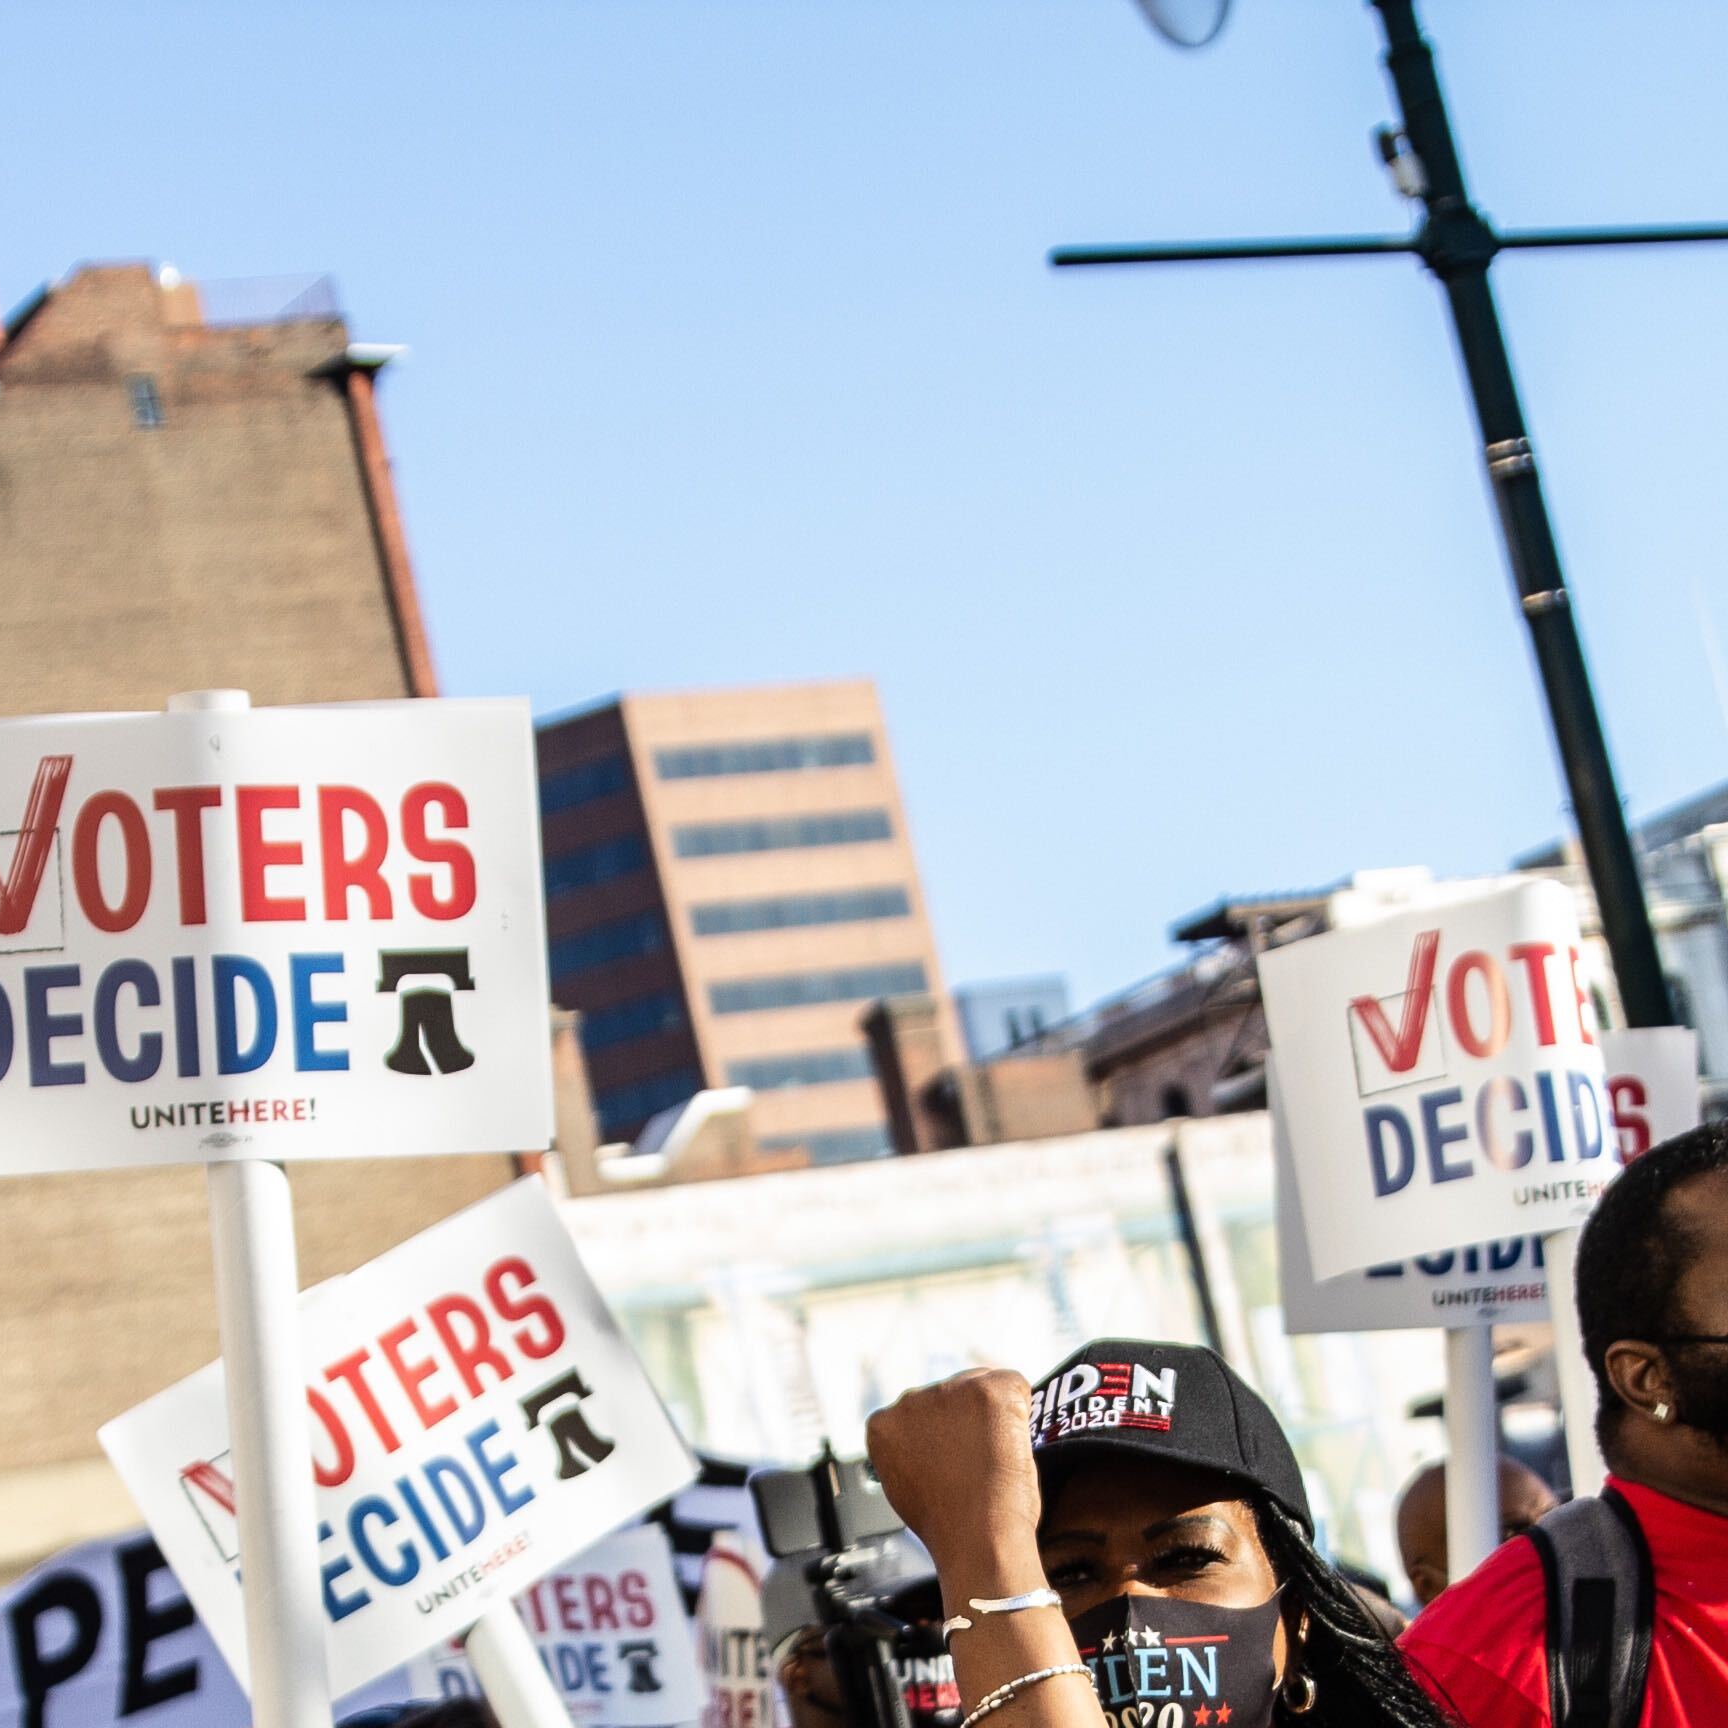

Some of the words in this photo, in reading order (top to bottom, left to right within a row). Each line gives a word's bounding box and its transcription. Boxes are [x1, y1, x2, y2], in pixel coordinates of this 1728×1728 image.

[130, 1098, 318, 1131] UNITEHERE!
[1364, 1069, 1614, 1198] DECID
[1030, 1397, 1175, 1436] RESIDENT
[1058, 1410, 1121, 1437] 2020
[315, 1416, 537, 1624] ECIDE
[526, 1569, 654, 1633] TERS
